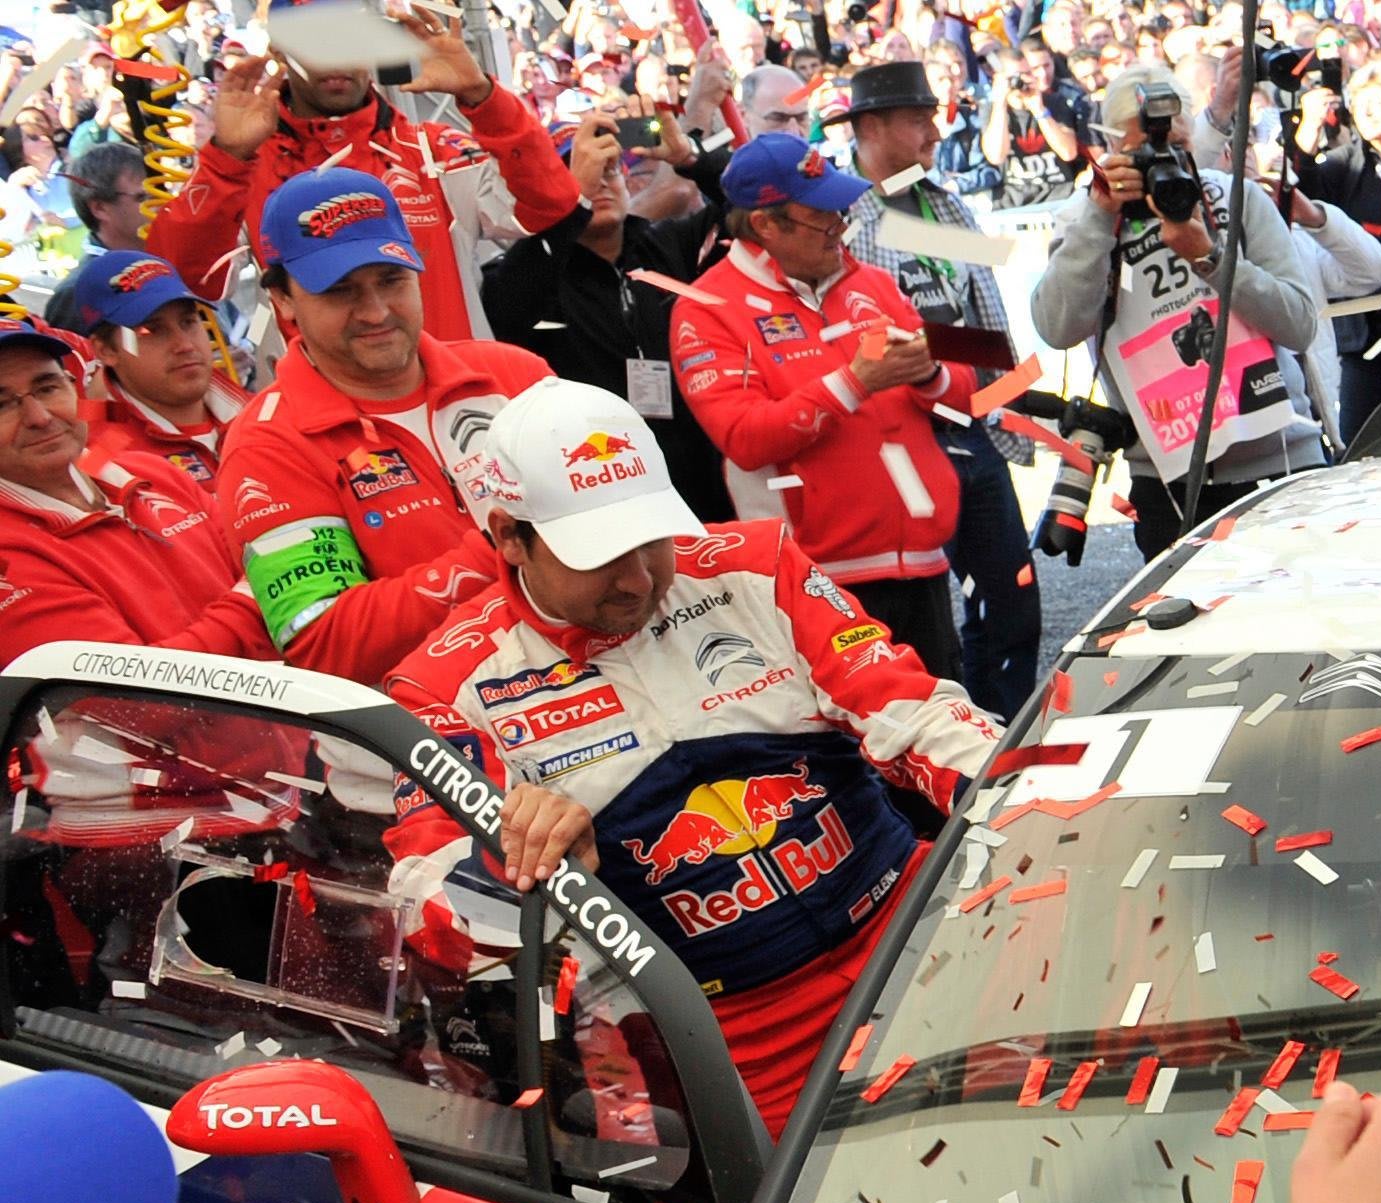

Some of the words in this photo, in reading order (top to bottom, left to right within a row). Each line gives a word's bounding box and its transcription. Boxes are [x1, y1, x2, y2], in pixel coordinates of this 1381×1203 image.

[1158, 407, 1202, 447] 201
[354, 477, 390, 498] Red
[389, 468, 419, 490] Bull
[568, 464, 612, 492] Red
[615, 456, 647, 480] Bull
[386, 497, 442, 519] LUHTA
[267, 557, 353, 601] CITROËN
[152, 660, 294, 701] FINANCEMENT
[701, 666, 795, 713] CITROËn
[420, 713, 465, 729] TAL
[530, 695, 618, 730] TOTAL
[544, 734, 634, 775] MICHELIN
[409, 738, 657, 978] CITROERC.COM
[661, 856, 777, 938] Red
[771, 802, 854, 895] Bull
[199, 1103, 338, 1130] TOTAL
